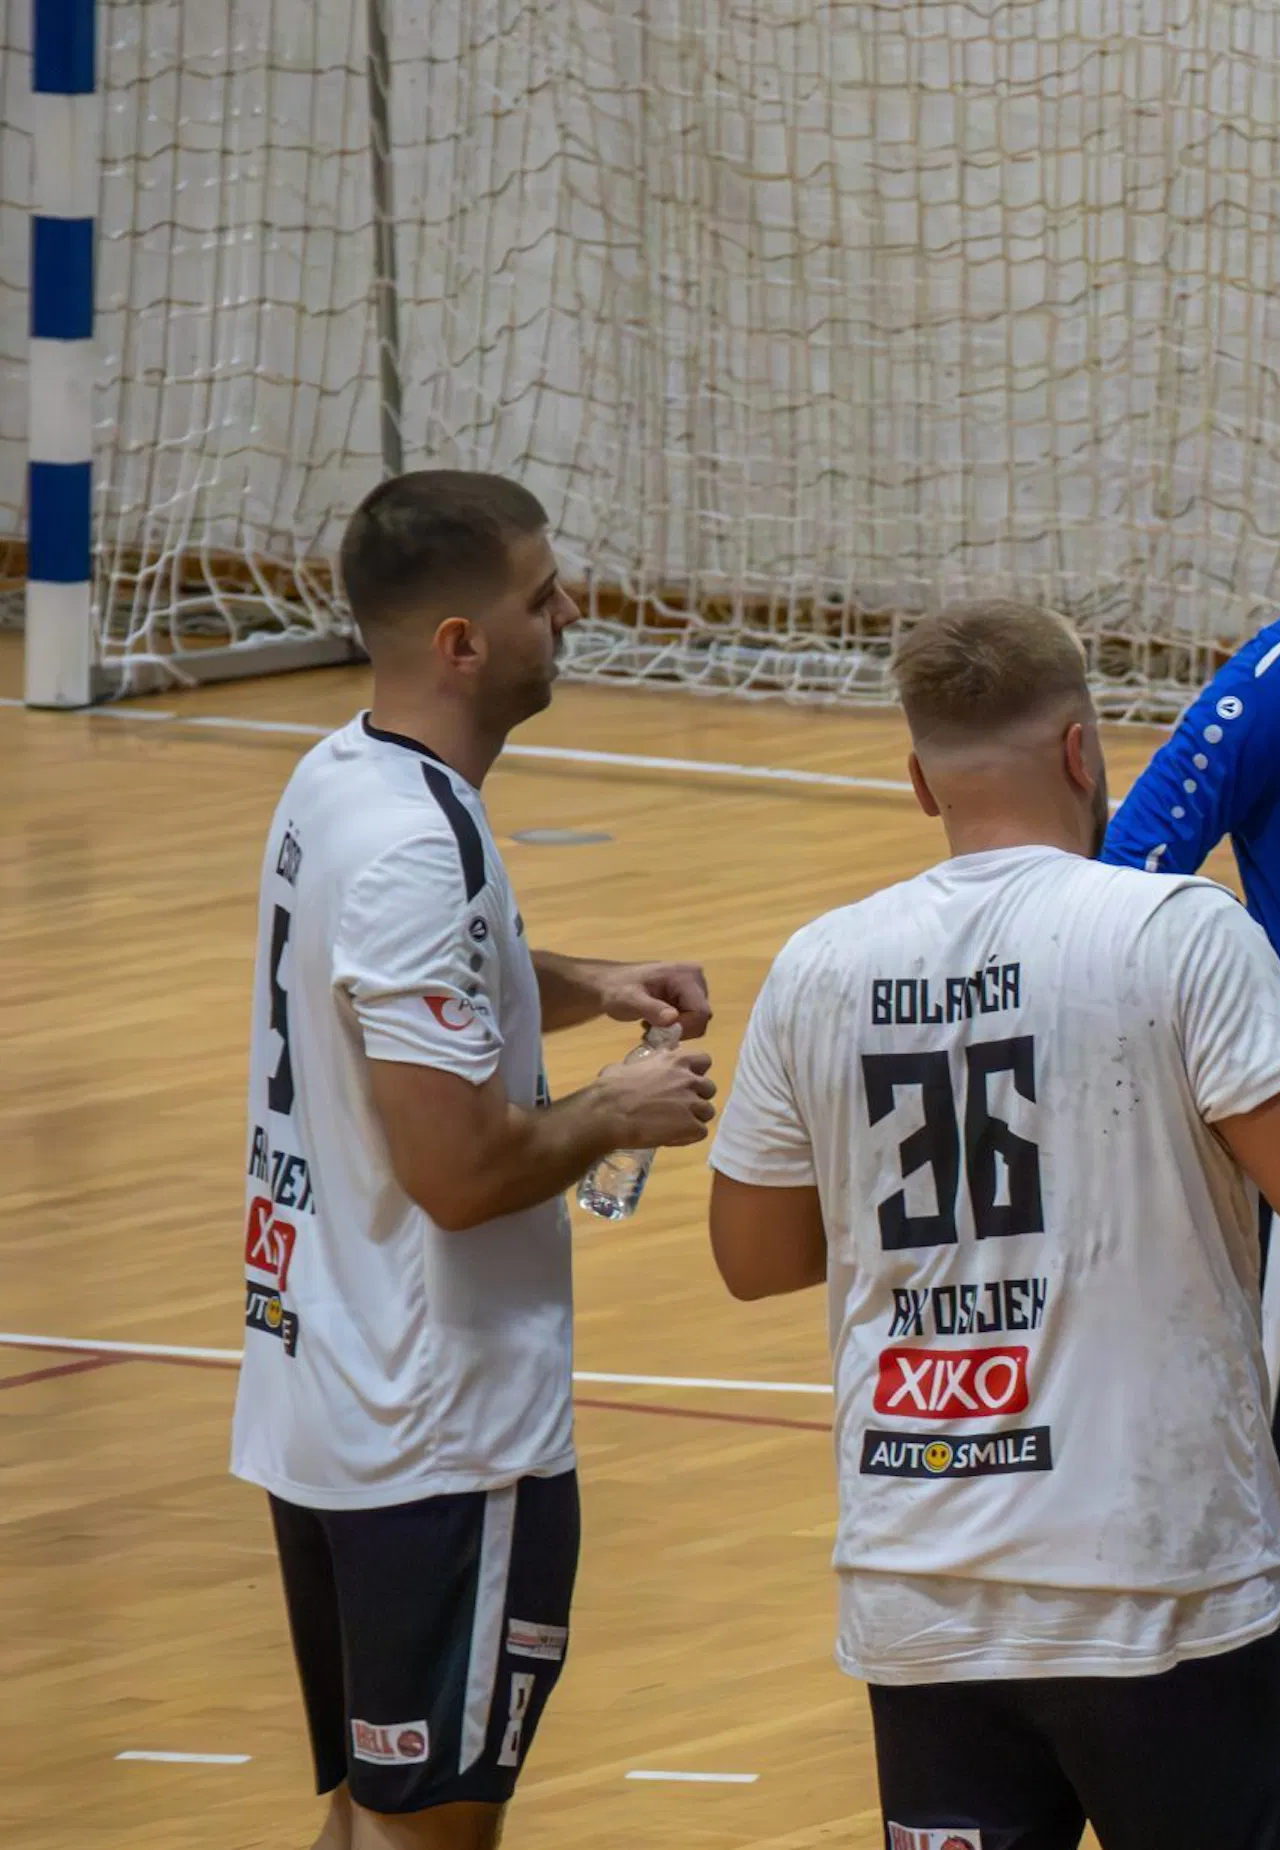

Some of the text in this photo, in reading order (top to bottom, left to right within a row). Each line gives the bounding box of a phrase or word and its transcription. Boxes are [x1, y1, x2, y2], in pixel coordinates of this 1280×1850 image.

[860, 1034, 1046, 1251] 36
[886, 1355, 1021, 1412] XIXO
[953, 1435, 1037, 1469] SMILE
